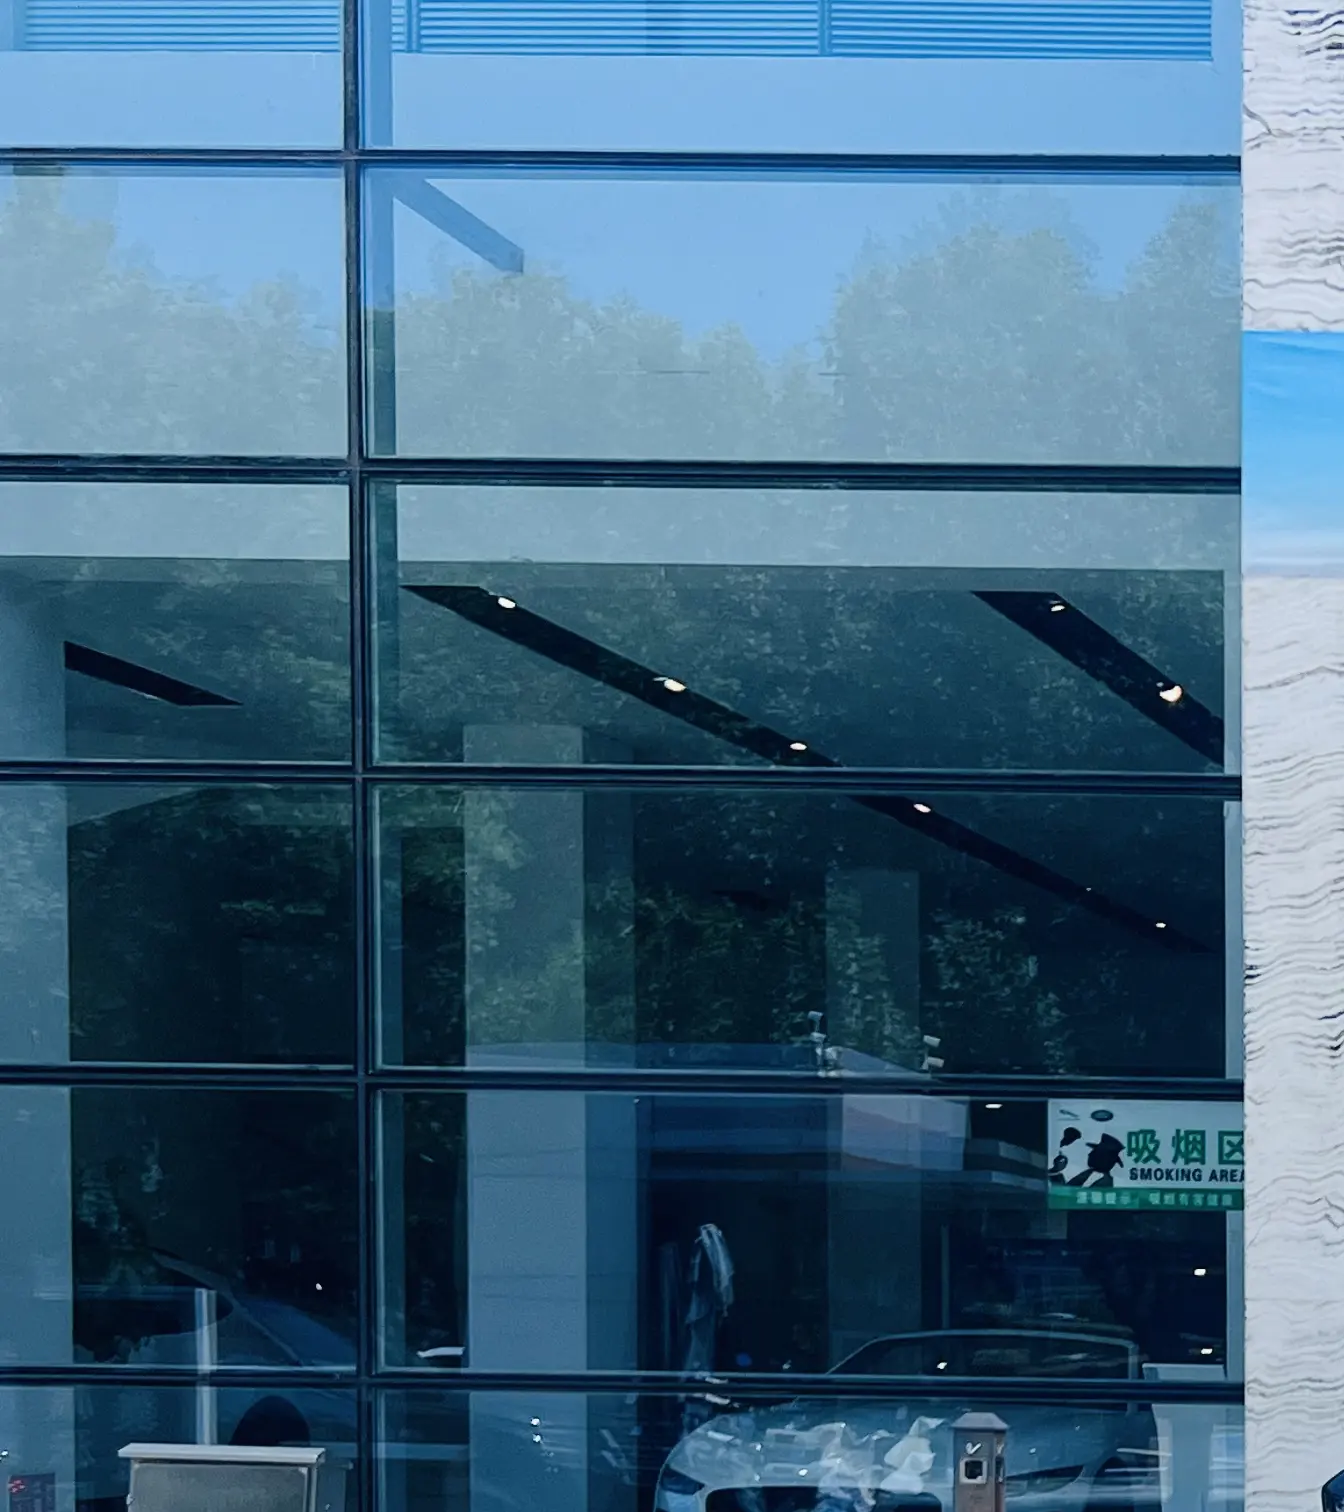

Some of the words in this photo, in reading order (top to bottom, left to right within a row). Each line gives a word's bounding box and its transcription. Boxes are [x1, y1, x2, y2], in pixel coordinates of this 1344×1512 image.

[1127, 1129, 1244, 1165] 吸烟区
[1129, 1167, 1202, 1182] SMOKING
